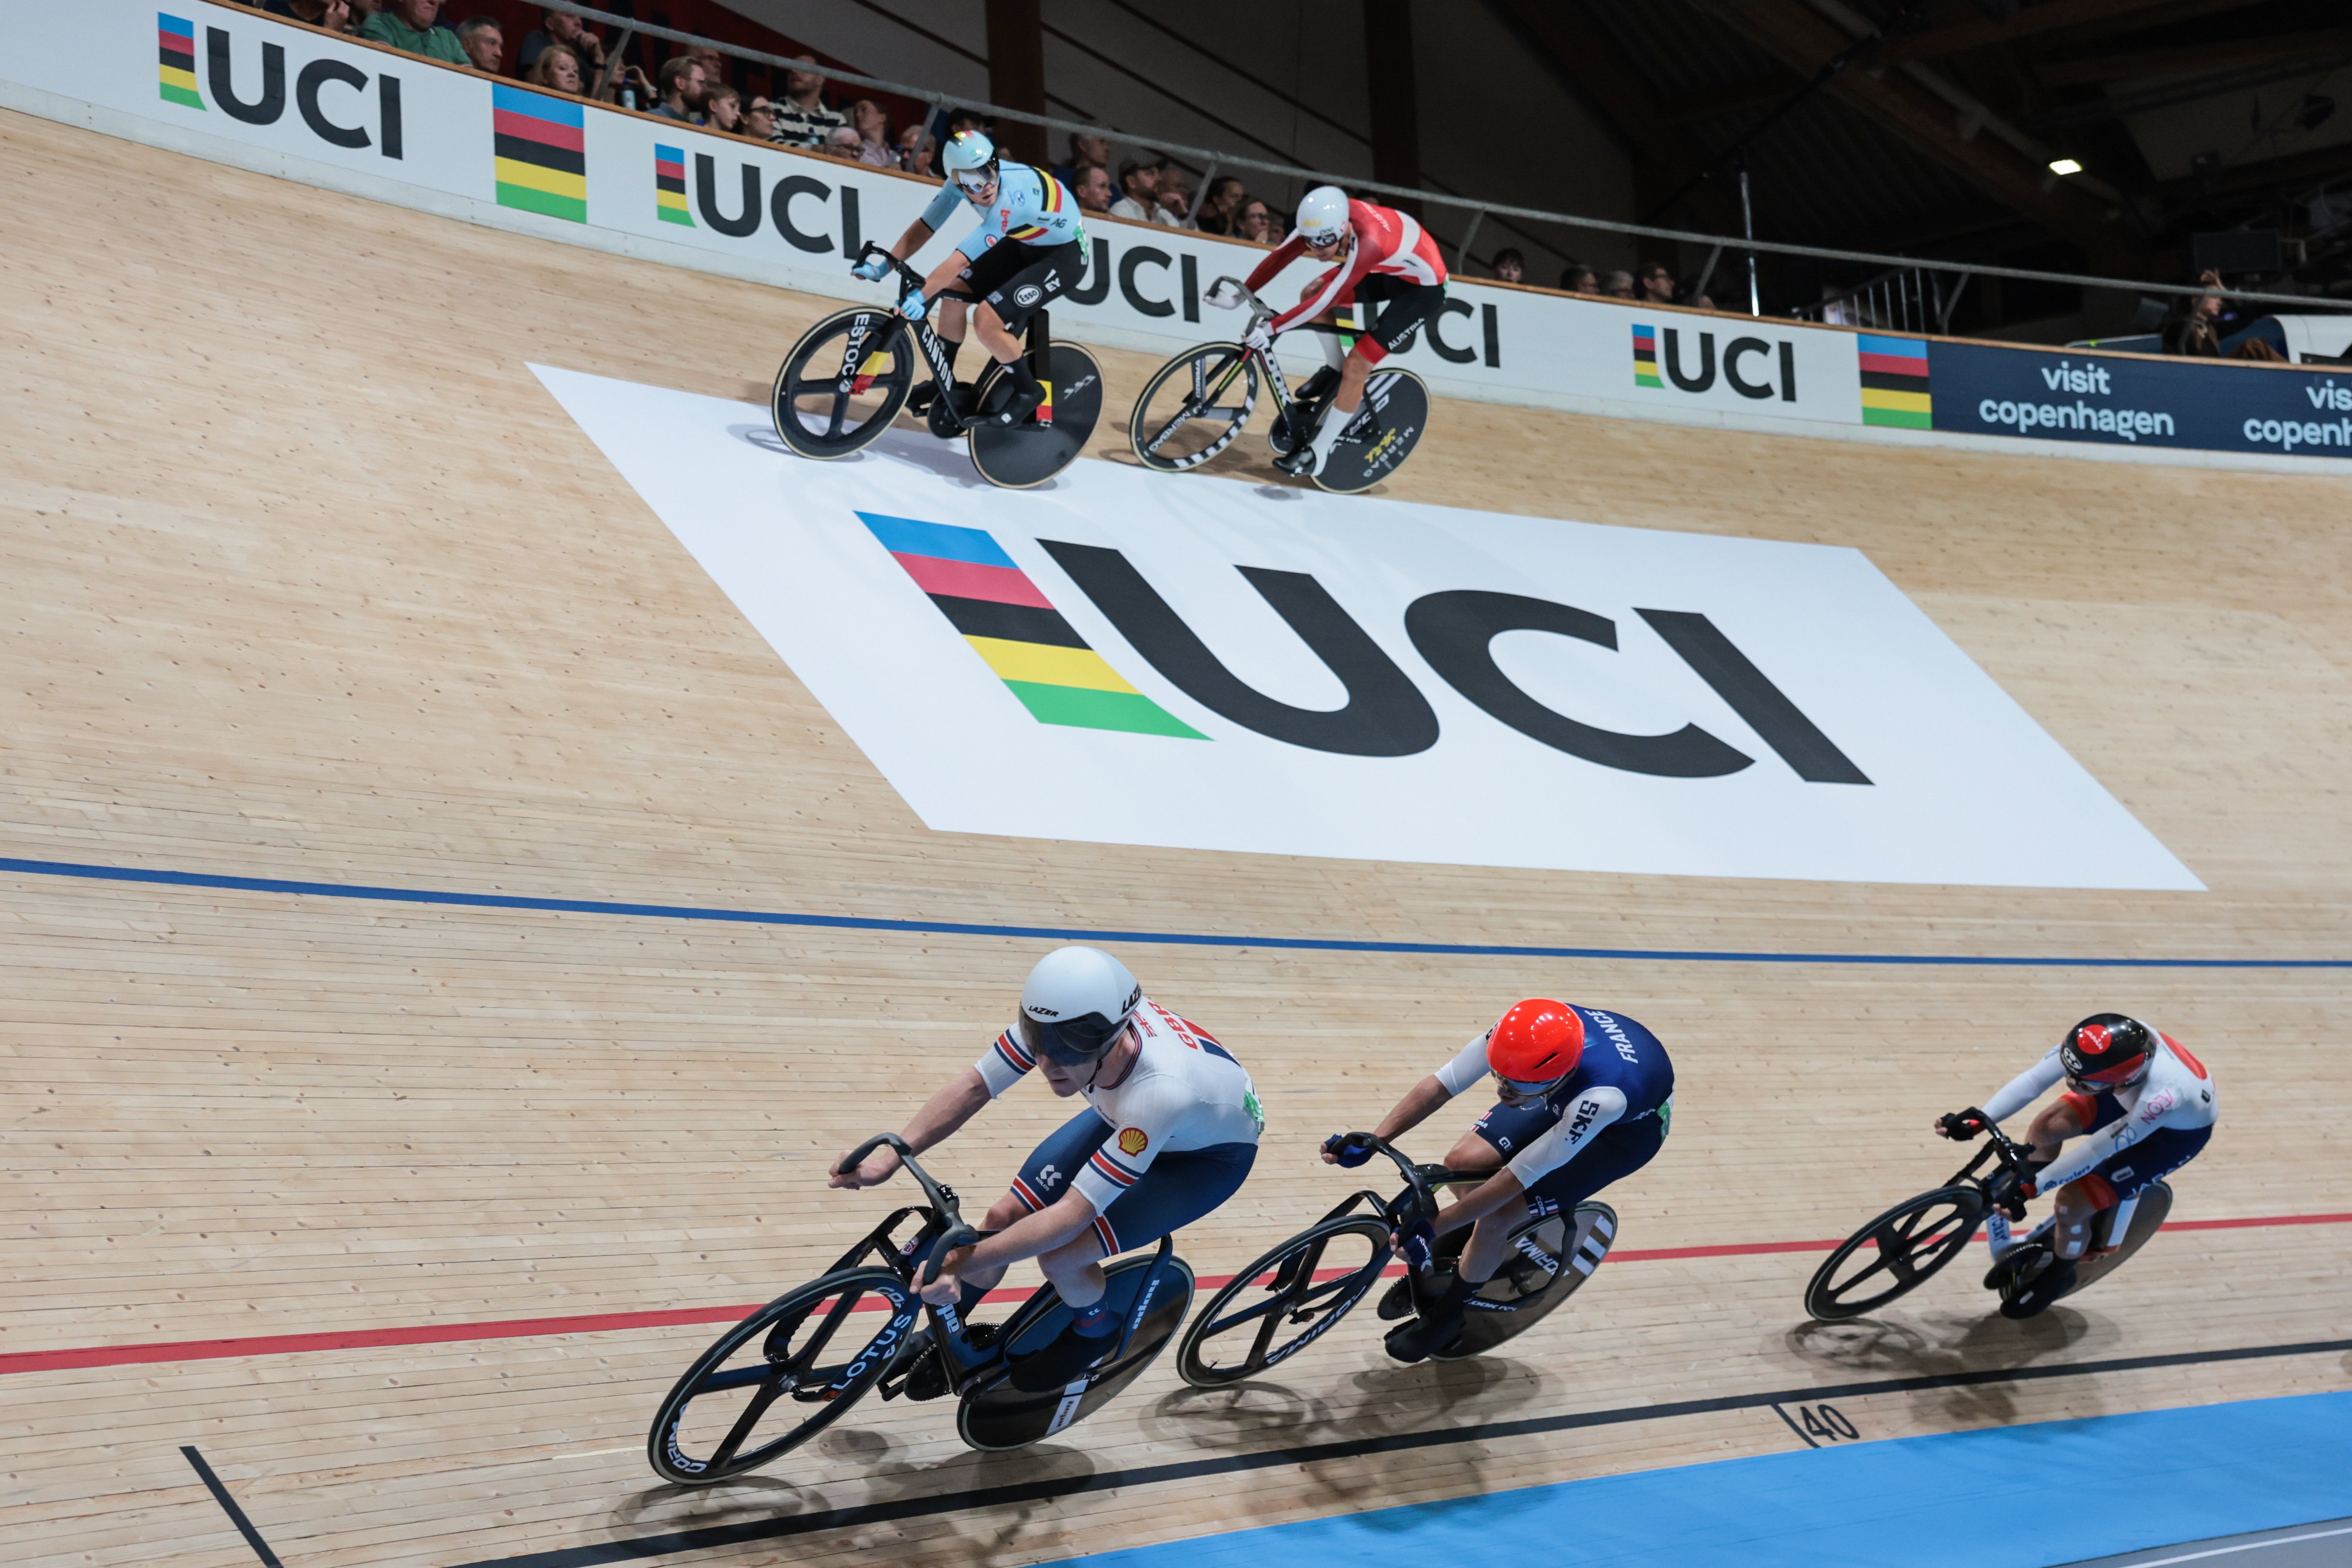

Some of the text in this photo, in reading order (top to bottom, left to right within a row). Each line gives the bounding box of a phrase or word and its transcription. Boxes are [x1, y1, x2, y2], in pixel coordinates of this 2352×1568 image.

[206, 25, 403, 160] UCI
[695, 152, 861, 260] UCI
[1044, 277, 1061, 293] EY
[842, 314, 870, 376] ESTOC
[1387, 317, 1425, 351] AUSTRIA
[921, 324, 954, 392] CANYON
[1663, 327, 1797, 403] UCI
[2041, 361, 2111, 395] visit
[2305, 379, 2352, 411] vis
[1148, 411, 1191, 452] MERBAG
[1979, 399, 2175, 441] copenhagen
[1363, 426, 1414, 478] MERBAG
[1035, 538, 1875, 786] UCI
[1029, 1005, 1060, 1018] LAZER
[1147, 1001, 1198, 1050] GBR
[1584, 1010, 1638, 1064] FRANCE
[1568, 1100, 1600, 1145] SKF
[1514, 1236, 1570, 1277] ORIMA
[936, 1303, 960, 1334] pe
[1132, 1279, 1160, 1330] hope
[831, 1314, 912, 1390] LOTUS
[1800, 1404, 1860, 1441] 40
